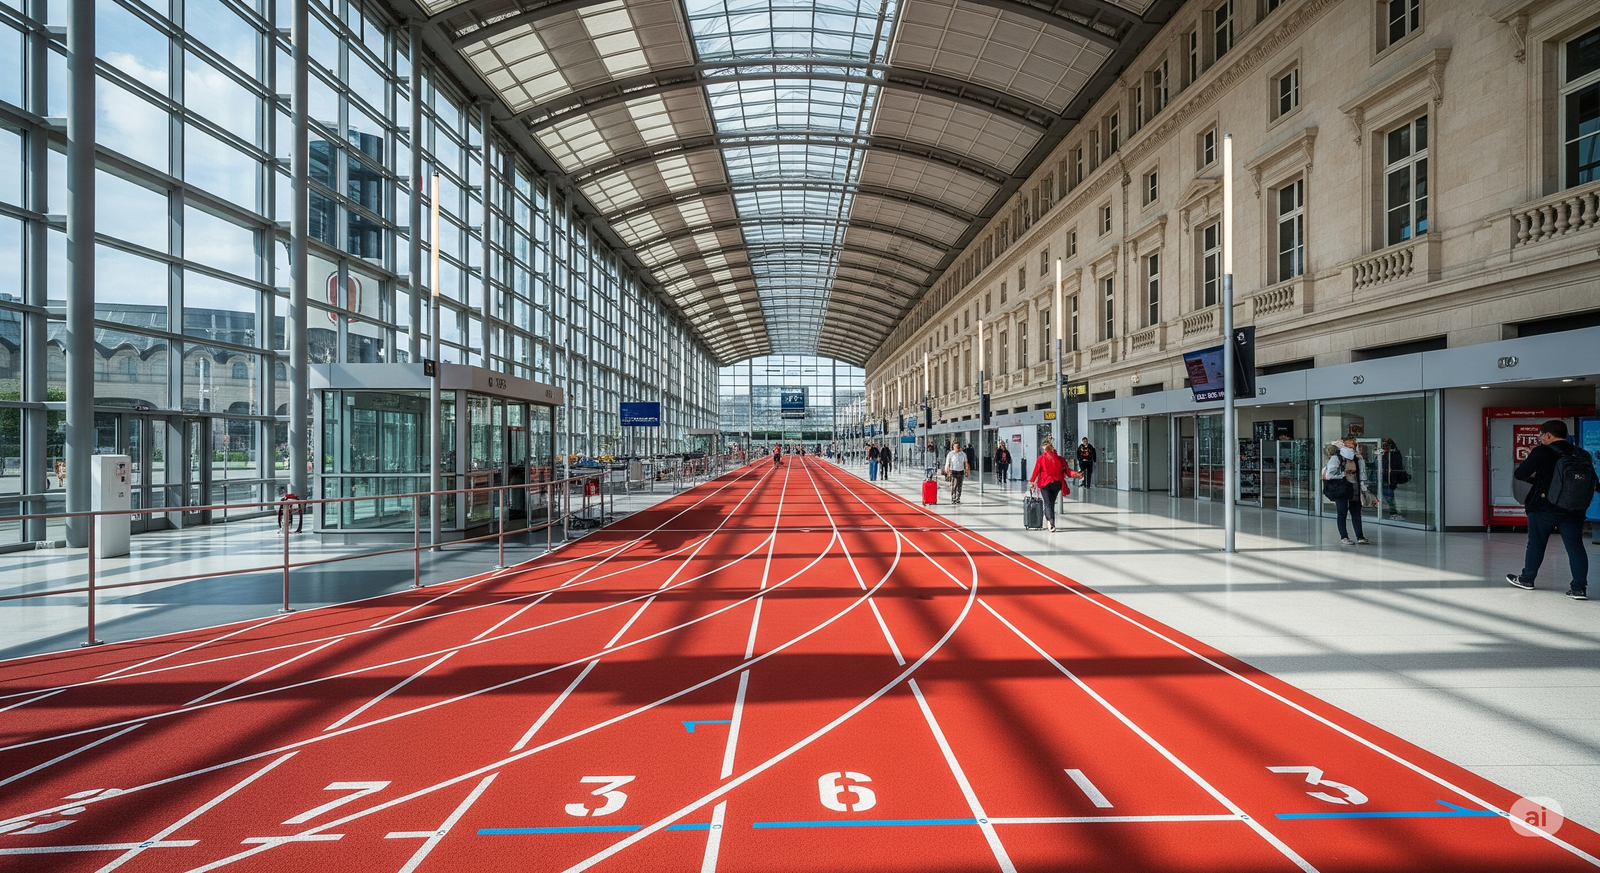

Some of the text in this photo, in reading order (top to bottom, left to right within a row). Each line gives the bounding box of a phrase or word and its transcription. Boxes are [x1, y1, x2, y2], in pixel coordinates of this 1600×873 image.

[281, 781, 392, 825] 7
[565, 776, 636, 817] 3
[818, 771, 877, 812] 6
